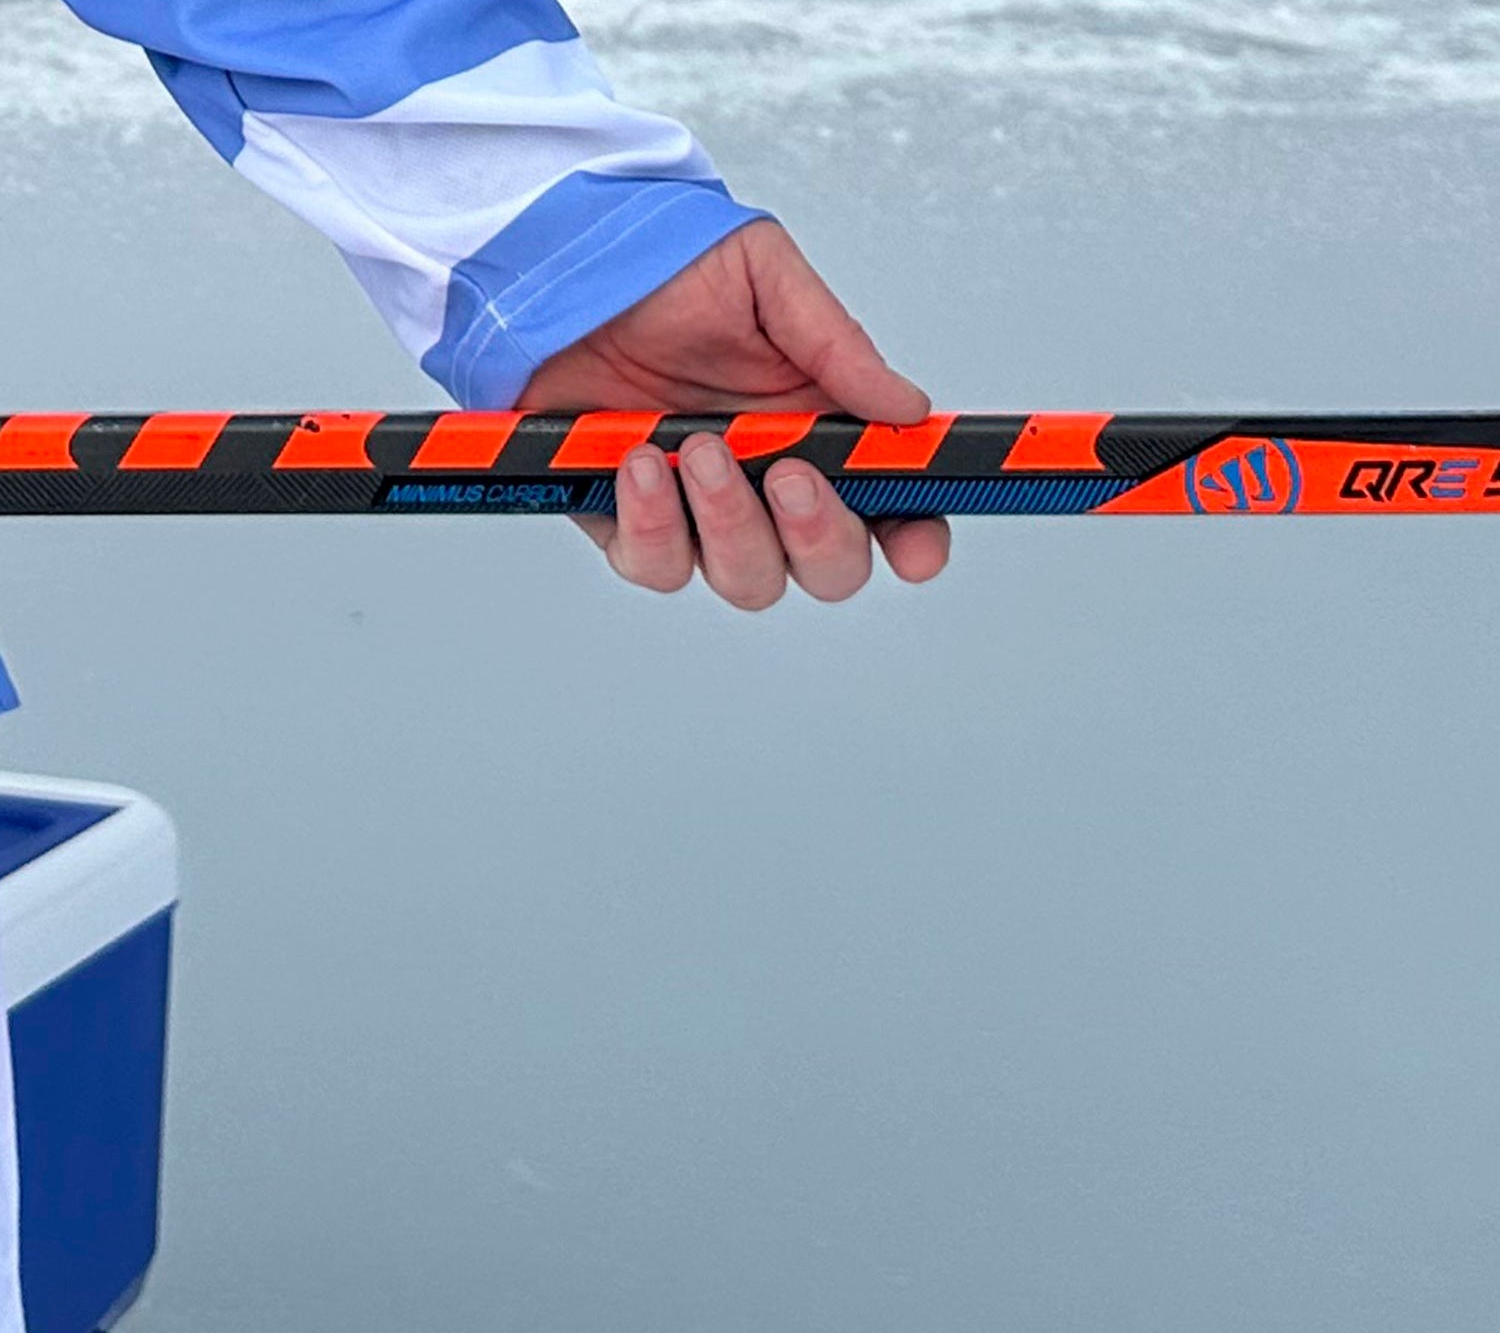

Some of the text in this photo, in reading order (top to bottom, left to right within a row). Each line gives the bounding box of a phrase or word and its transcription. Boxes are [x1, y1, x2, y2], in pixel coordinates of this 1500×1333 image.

[385, 484, 573, 503] MINIMUS CARBON
[1338, 459, 1479, 502] QRE
